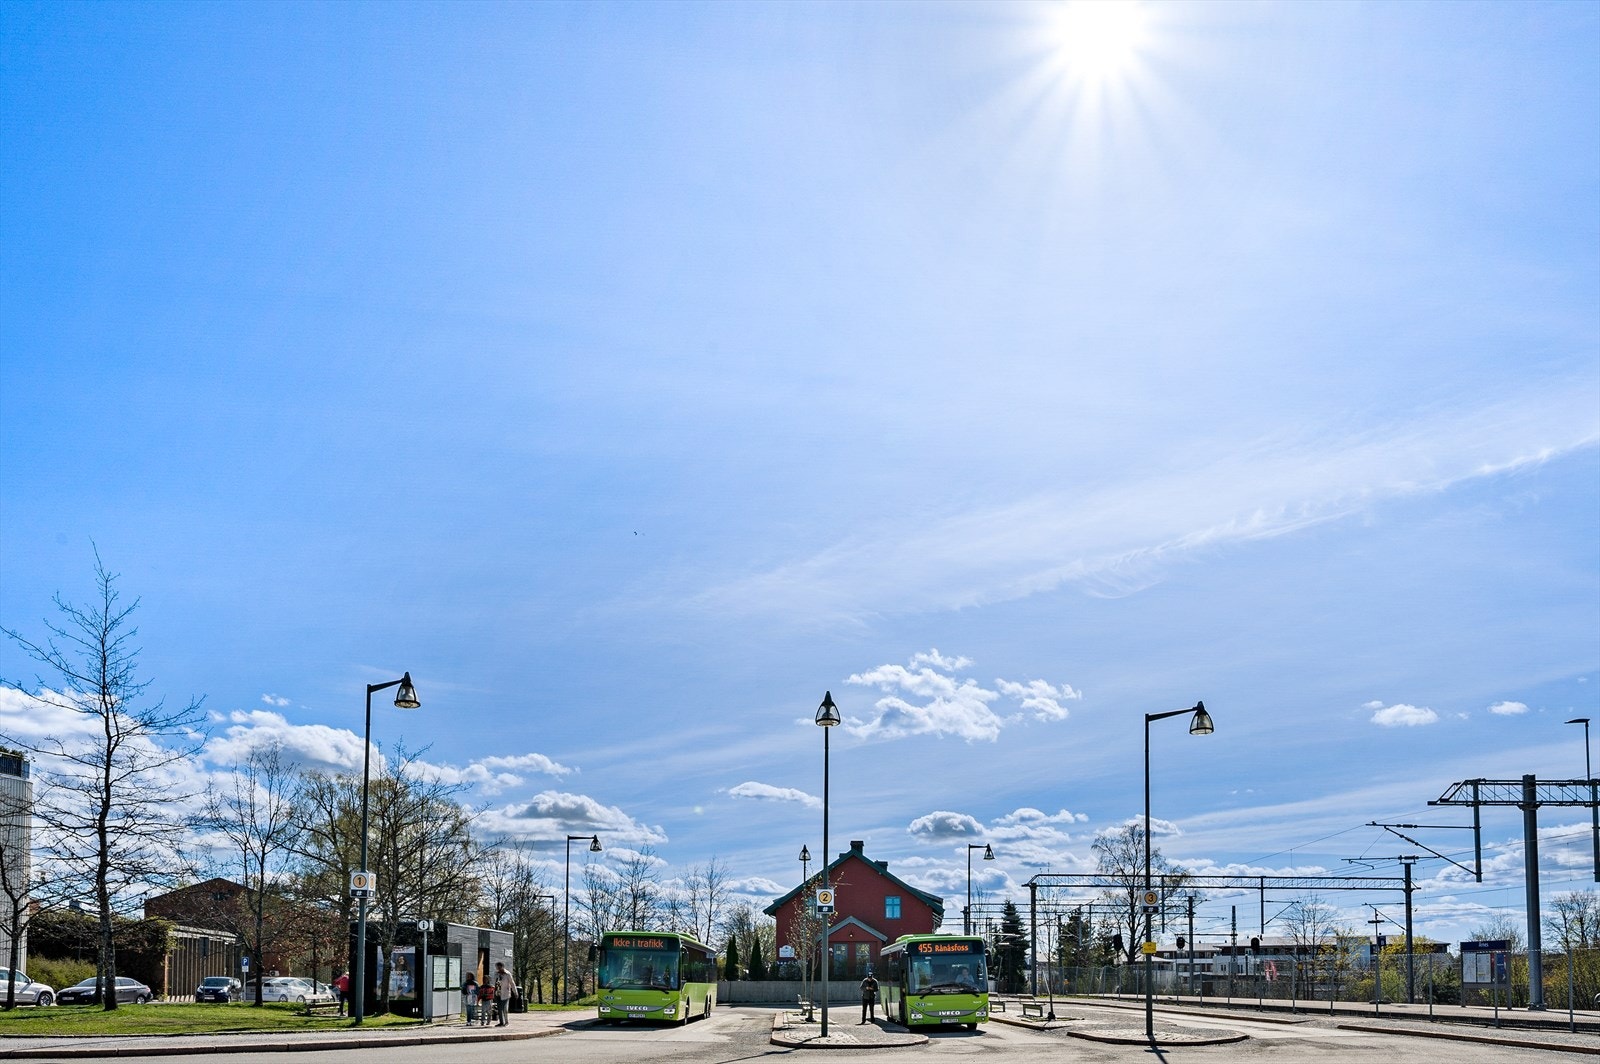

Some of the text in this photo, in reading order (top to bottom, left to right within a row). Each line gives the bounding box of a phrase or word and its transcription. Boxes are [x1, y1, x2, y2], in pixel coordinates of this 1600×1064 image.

[822, 893, 828, 901] 2
[1148, 893, 1154, 902] 3
[613, 938, 630, 947] Ikke
[637, 939, 664, 948] trafikk
[918, 943, 933, 953] 455
